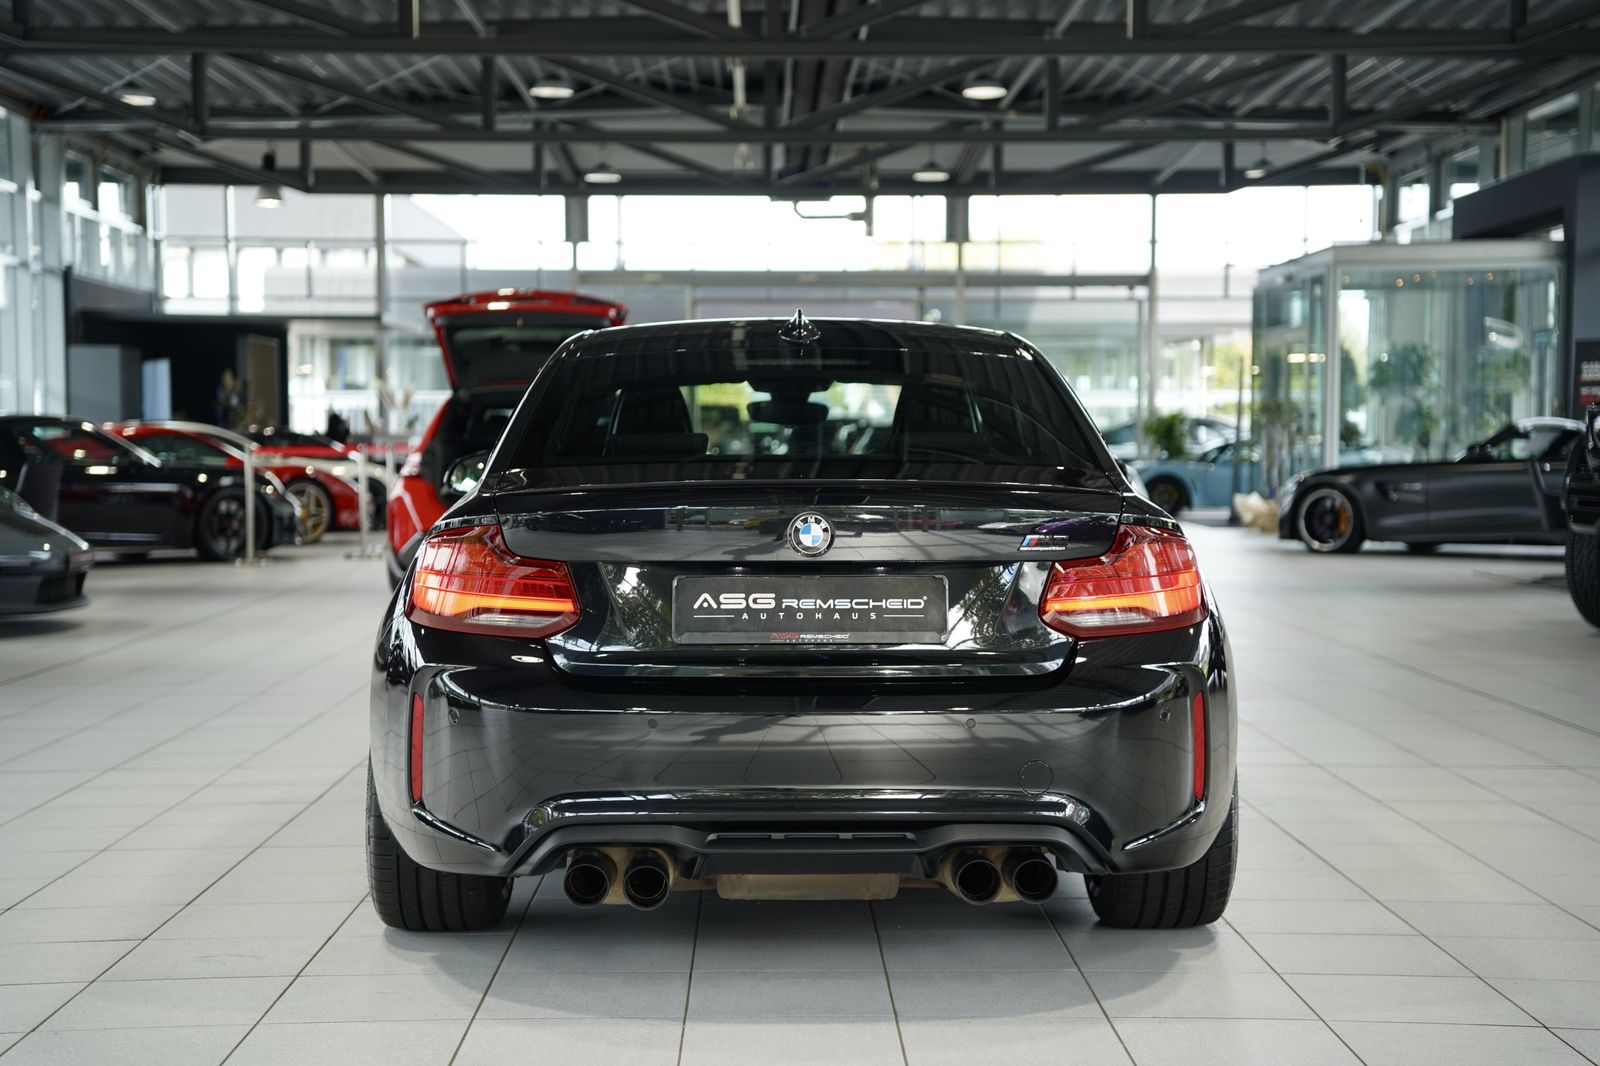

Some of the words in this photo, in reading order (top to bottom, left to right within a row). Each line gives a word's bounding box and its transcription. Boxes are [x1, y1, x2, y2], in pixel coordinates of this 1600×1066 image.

[795, 515, 829, 529] BMW
[693, 592, 776, 609] ASG
[781, 598, 925, 609] REMSCHEID
[741, 612, 877, 620] AUTOHAUS
